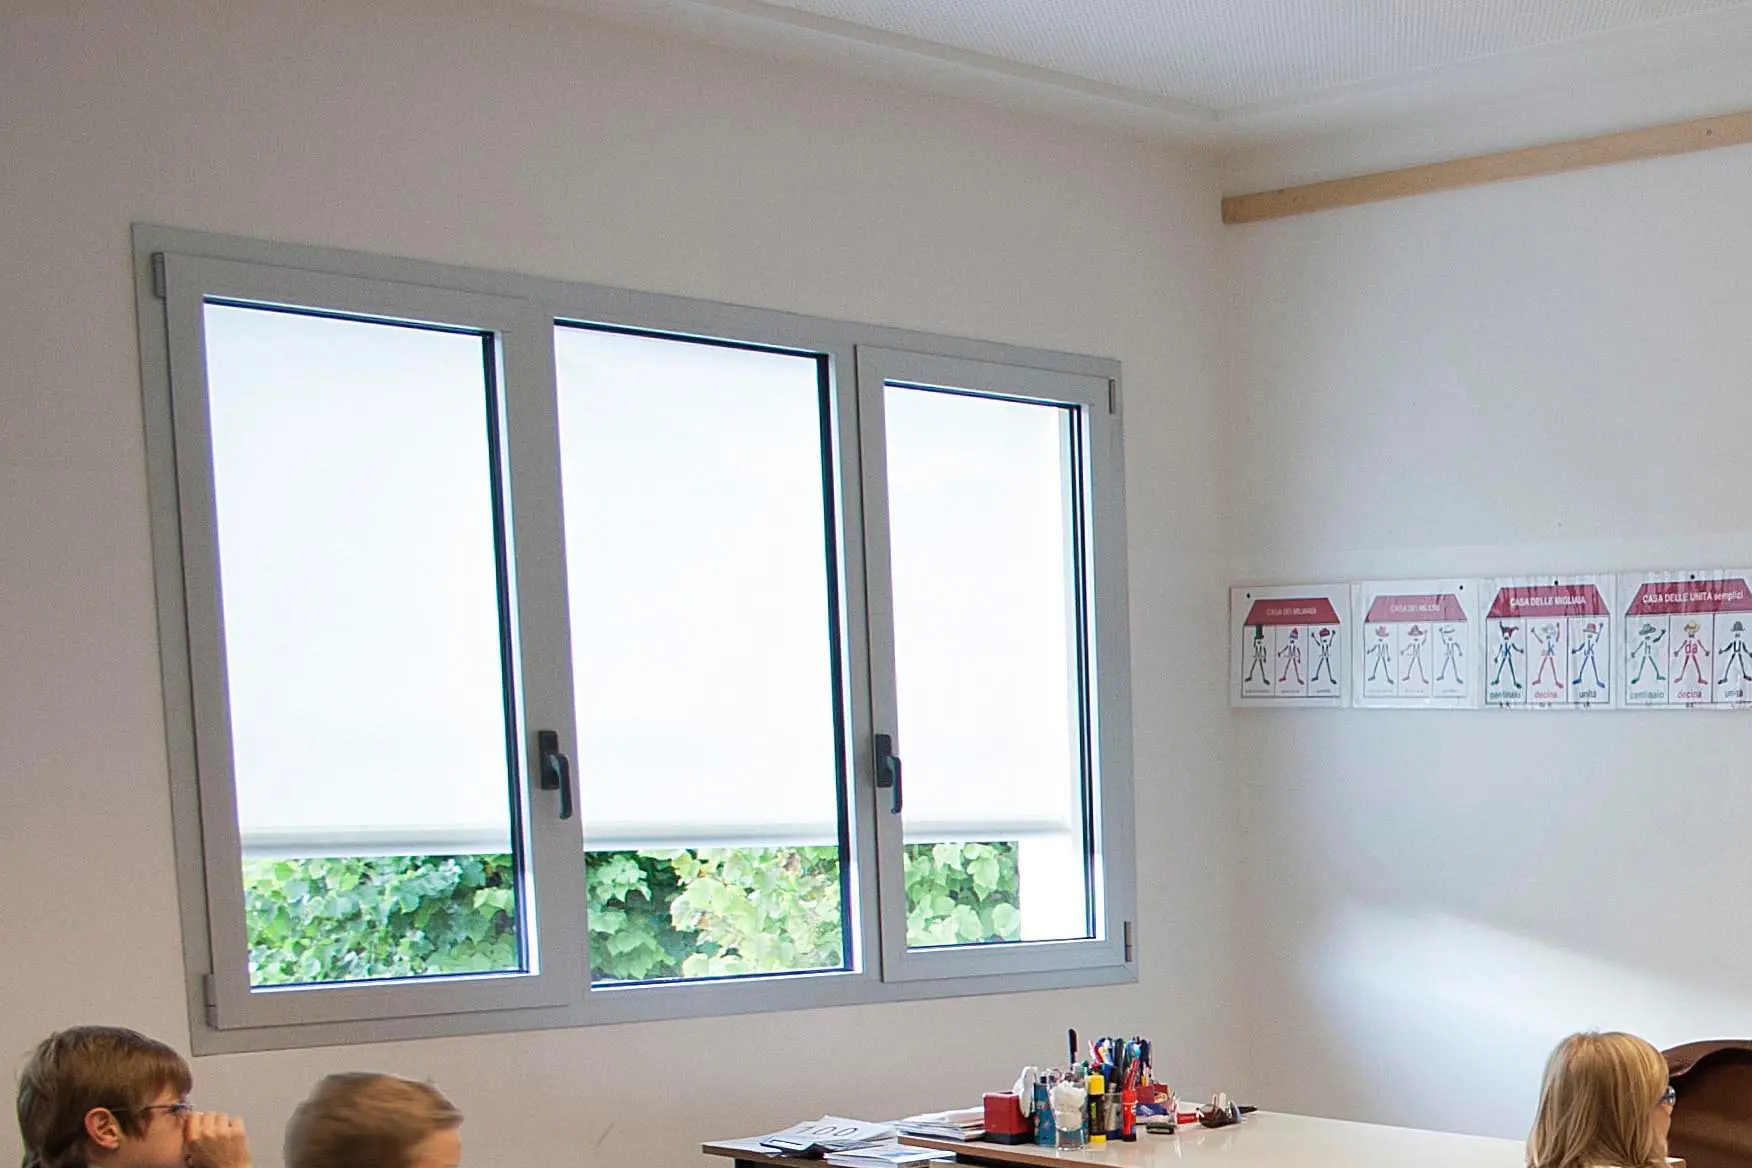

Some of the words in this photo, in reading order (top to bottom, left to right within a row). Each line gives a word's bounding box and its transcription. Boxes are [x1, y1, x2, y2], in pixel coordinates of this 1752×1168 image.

[1510, 598, 1529, 607] CASA
[1531, 596, 1553, 606] DELLE
[1643, 594, 1664, 604] CASA
[1664, 592, 1689, 603] DELLE
[1714, 590, 1744, 602] semplici
